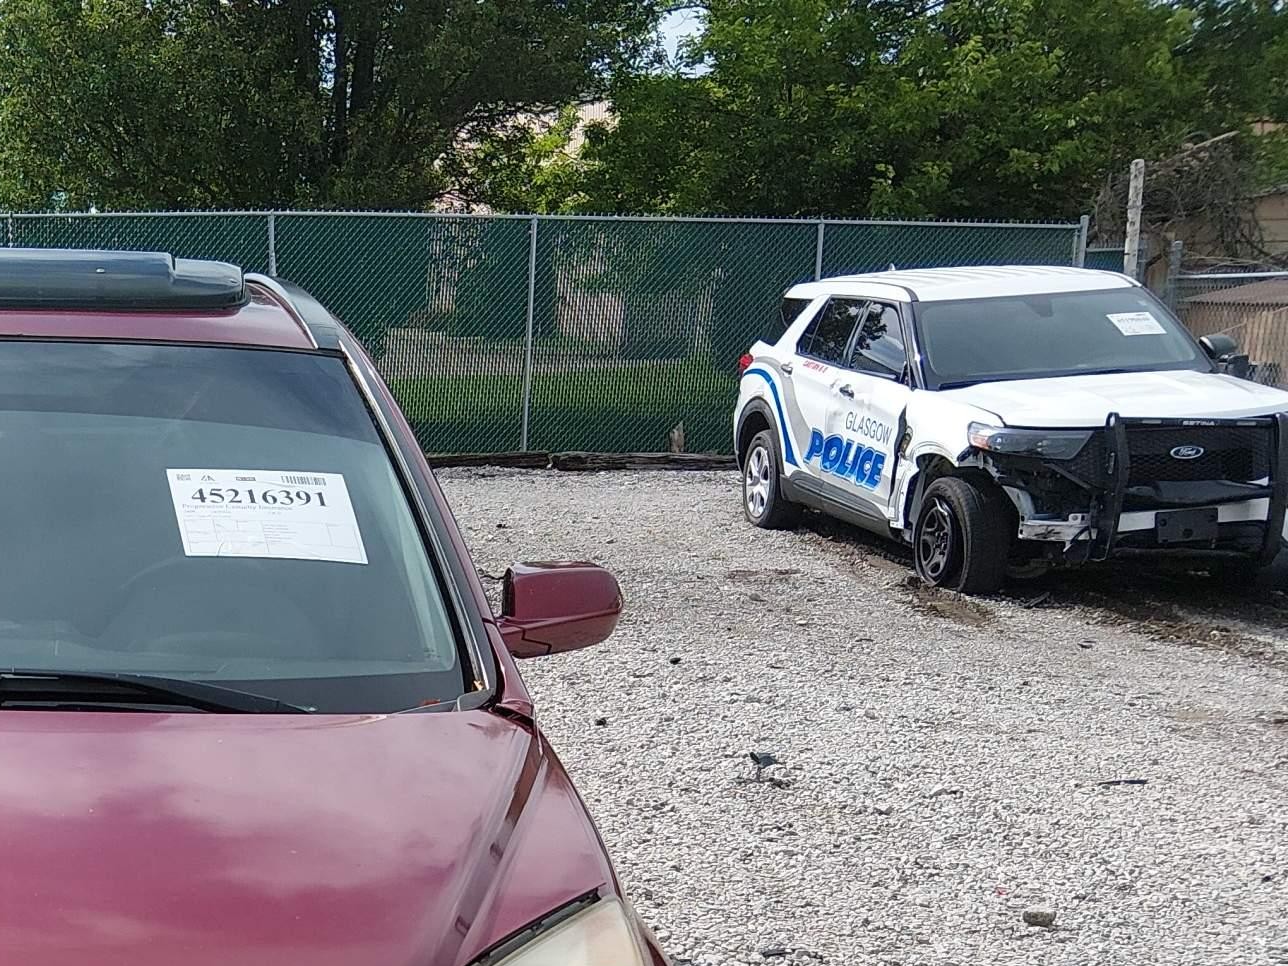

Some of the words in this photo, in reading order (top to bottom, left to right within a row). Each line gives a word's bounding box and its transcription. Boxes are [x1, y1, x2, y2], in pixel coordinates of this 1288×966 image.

[845, 411, 892, 446] GLASGOW
[803, 426, 887, 491] POLICE
[191, 487, 328, 507] 45216391
